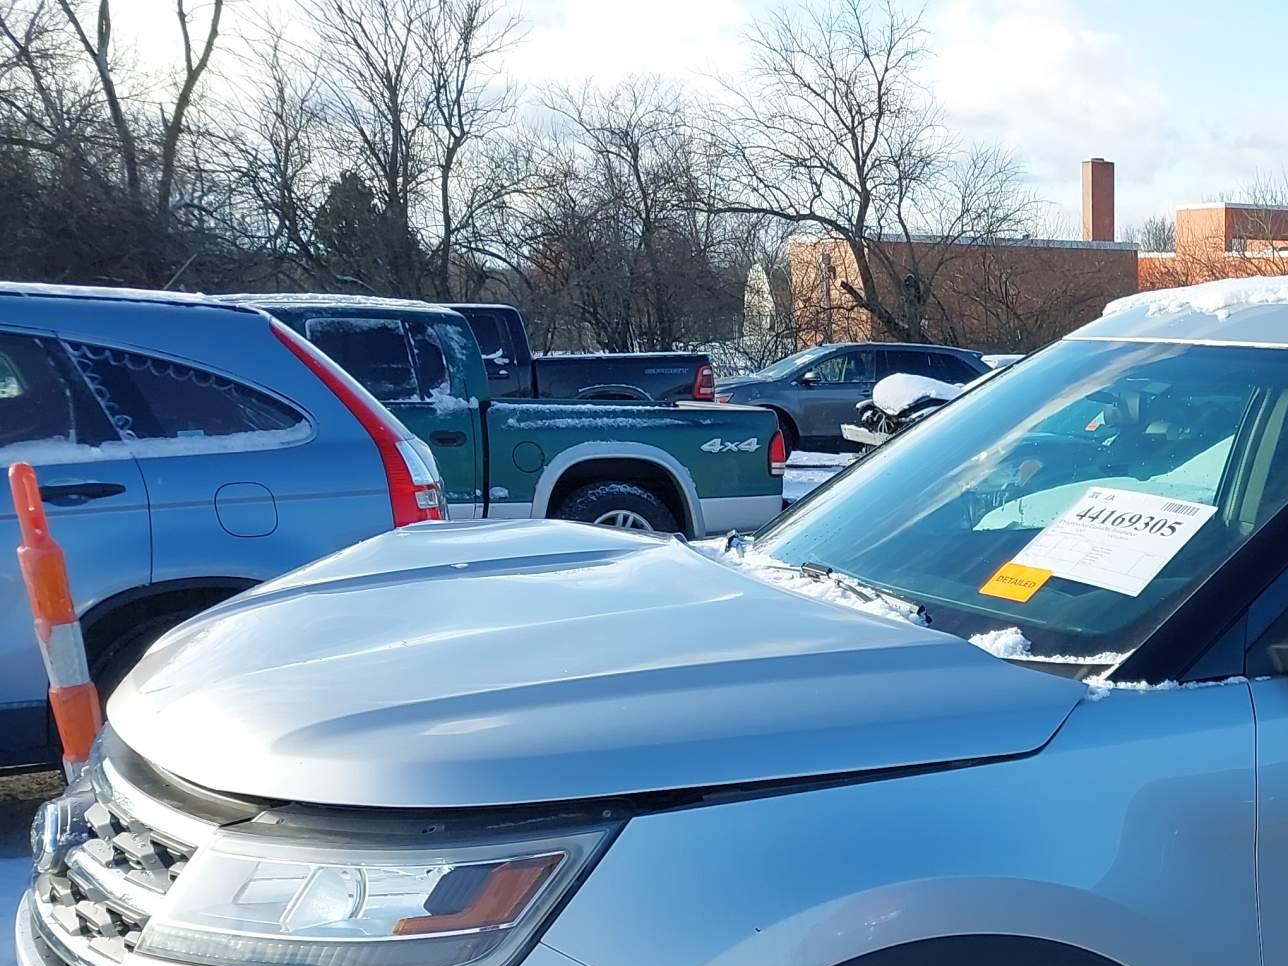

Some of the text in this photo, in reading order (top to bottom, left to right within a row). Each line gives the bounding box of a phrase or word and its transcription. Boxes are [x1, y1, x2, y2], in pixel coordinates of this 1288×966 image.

[700, 437, 761, 453] 4x4
[1076, 506, 1185, 537] 44169305
[995, 575, 1038, 589] DETAILED
